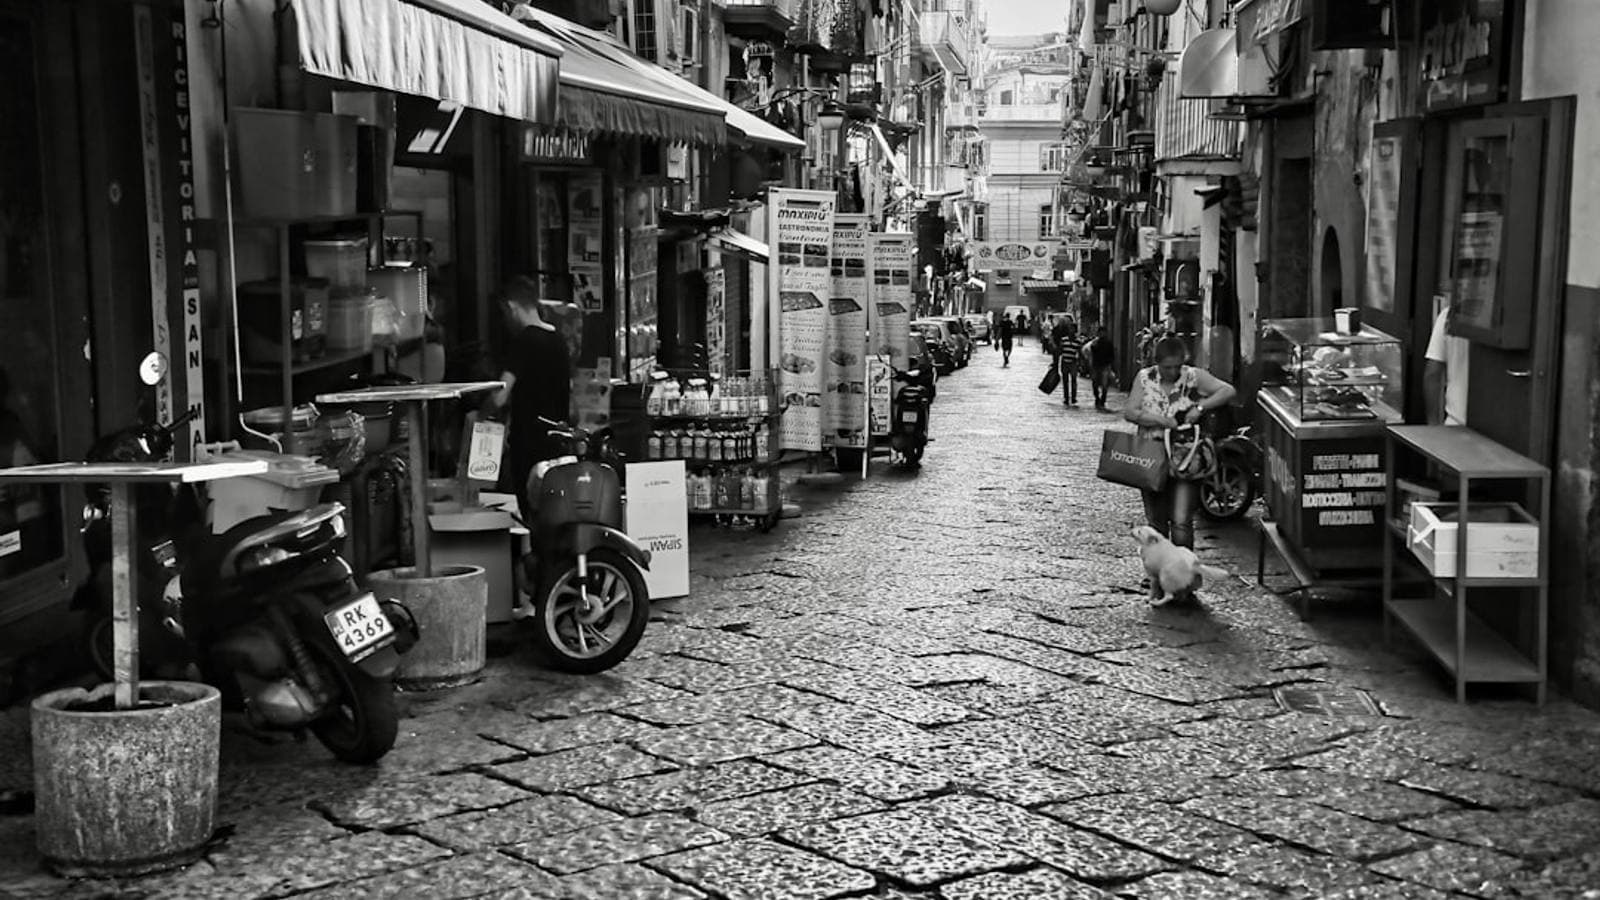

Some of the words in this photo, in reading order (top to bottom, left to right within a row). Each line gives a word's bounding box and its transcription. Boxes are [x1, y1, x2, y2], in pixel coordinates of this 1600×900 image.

[187, 297, 200, 369] SAN
[650, 538, 682, 552] SIPAM
[343, 604, 367, 627] RK
[344, 617, 385, 647] 4369
